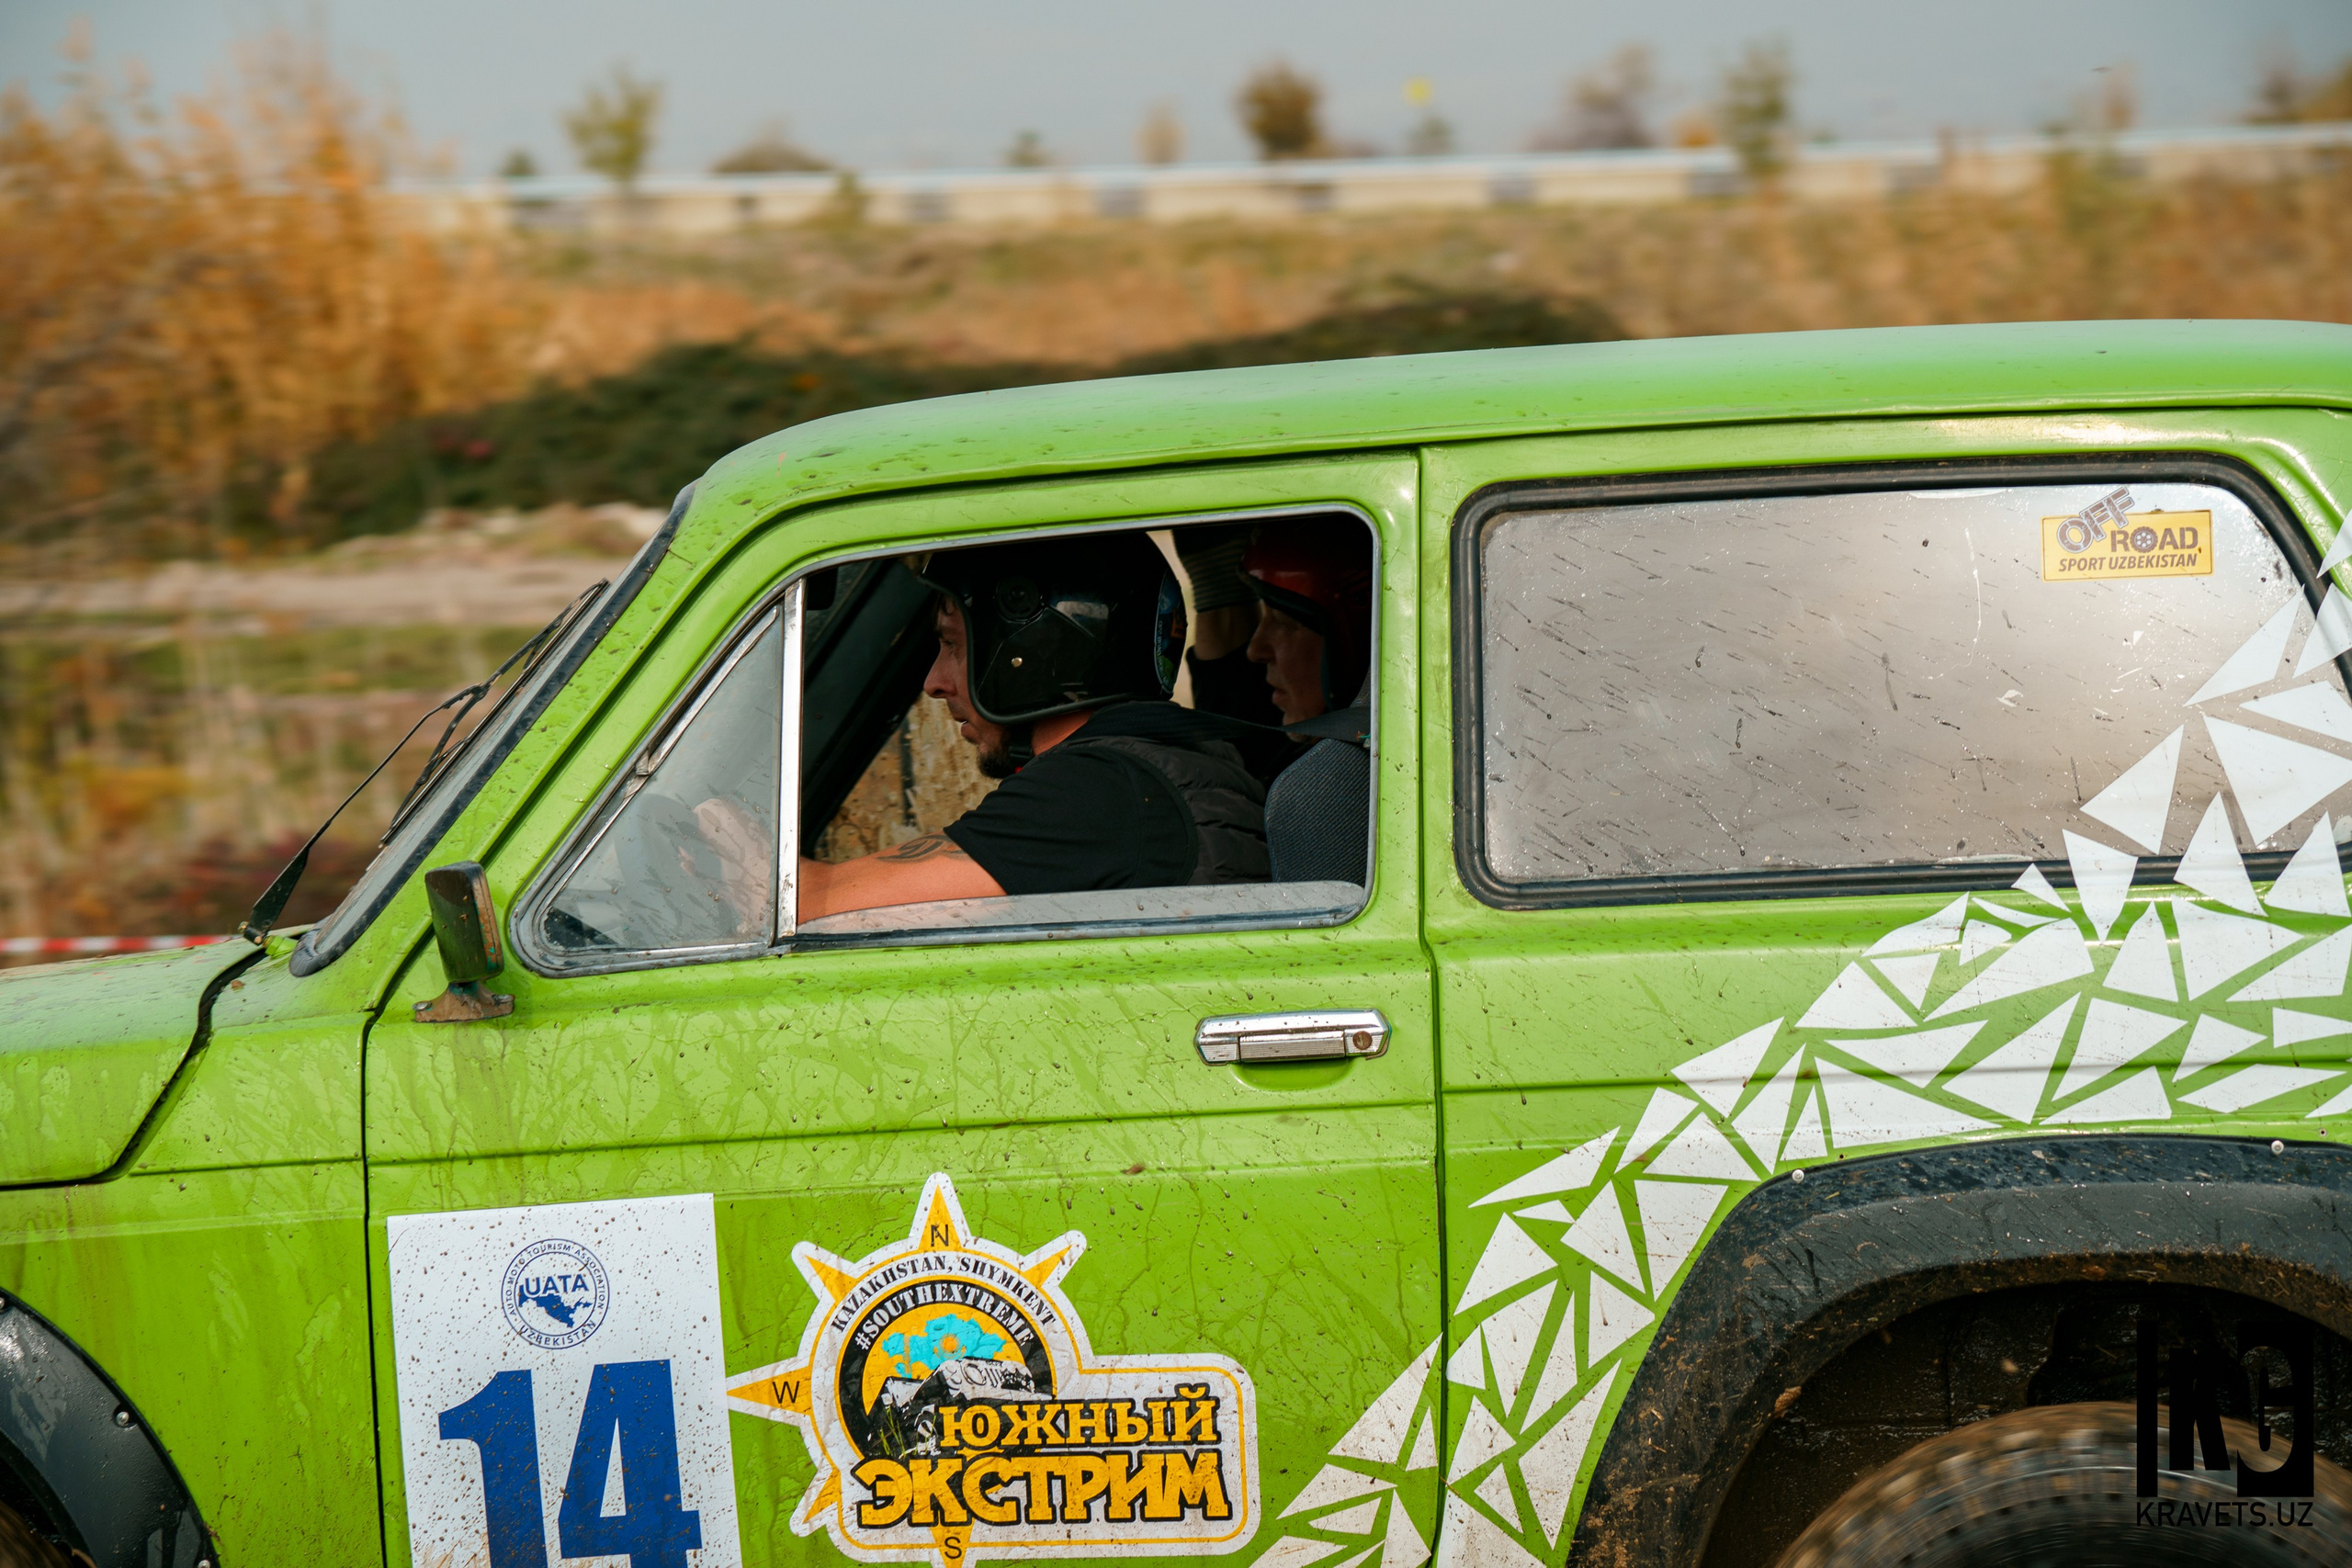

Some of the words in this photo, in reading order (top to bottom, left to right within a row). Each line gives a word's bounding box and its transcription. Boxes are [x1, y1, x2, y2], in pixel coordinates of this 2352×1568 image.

[2057, 486, 2135, 554] OFF
[2110, 526, 2199, 554] ROAD
[2059, 557, 2106, 572] SPORT
[2109, 553, 2197, 570] UZBEKISTAN
[931, 1224, 949, 1247] N
[525, 1274, 589, 1296] UATA
[527, 1243, 571, 1258] TOURISM
[574, 1249, 605, 1309] ASSOCIATION
[831, 1255, 953, 1333] KAZAKHSTAN,
[958, 1257, 1057, 1325] SHYMKENT
[520, 1320, 596, 1346] UZBEKISTAN
[854, 1283, 1035, 1350] #SOUTHEXTREME
[772, 1380, 800, 1405] W
[937, 1384, 1220, 1449] ЮЖНЫЙ
[437, 1359, 703, 1568] 14
[853, 1450, 1231, 1527] ЭКСТРИМ
[944, 1535, 963, 1560] S
